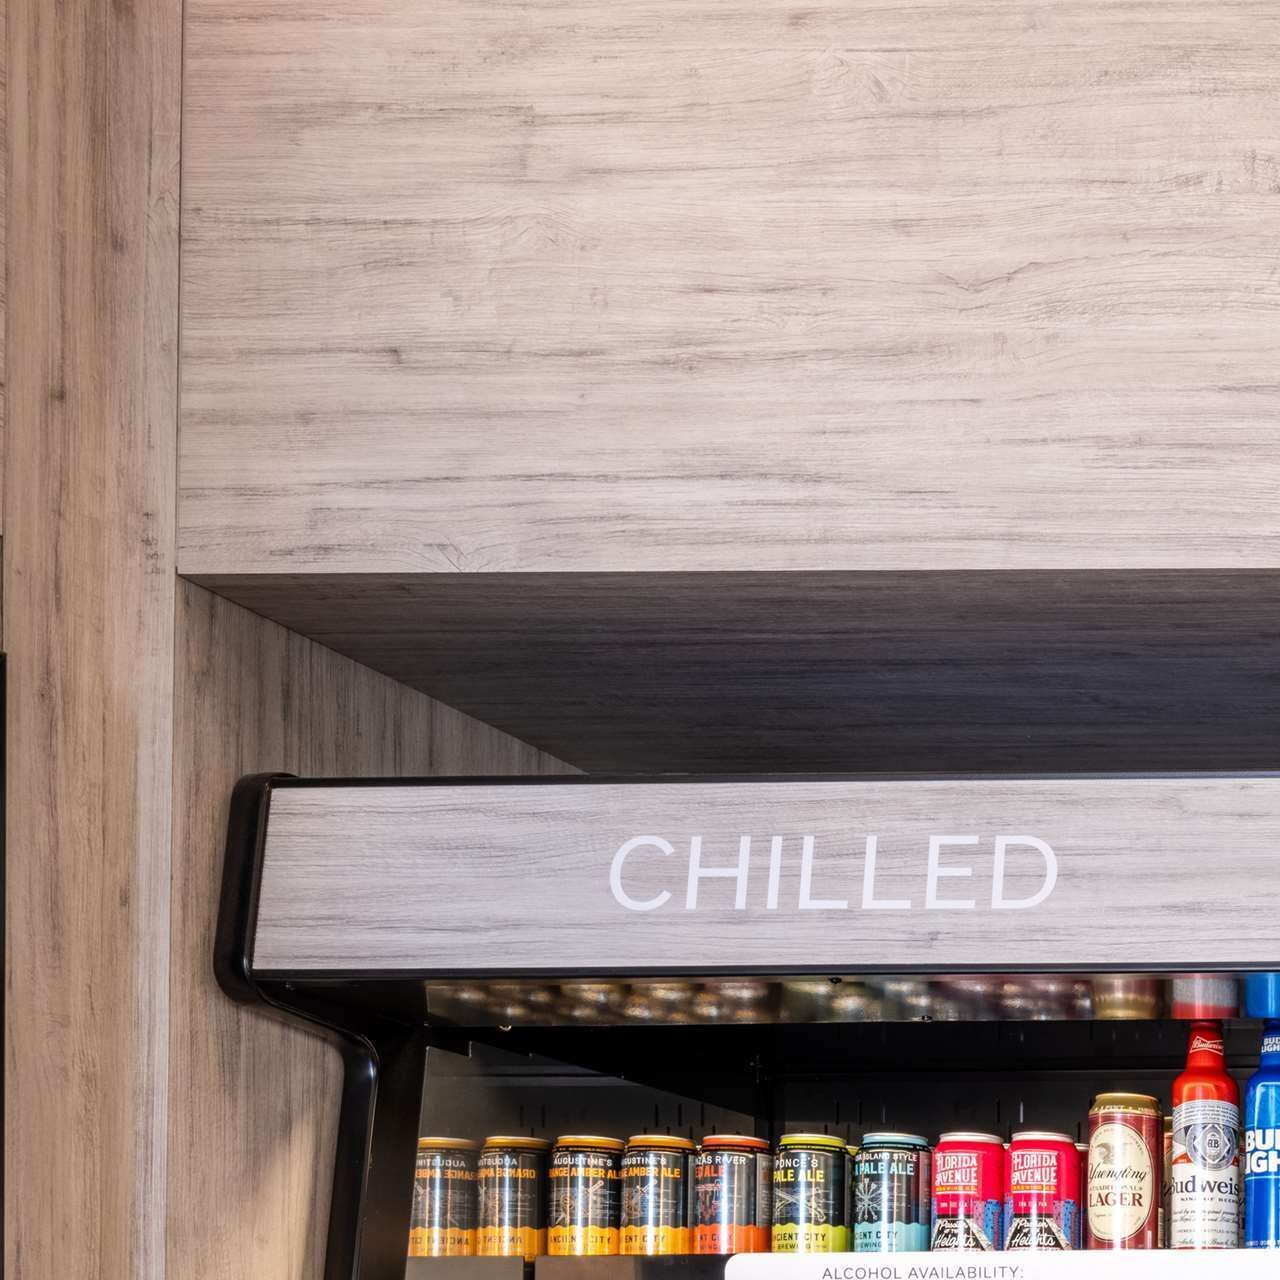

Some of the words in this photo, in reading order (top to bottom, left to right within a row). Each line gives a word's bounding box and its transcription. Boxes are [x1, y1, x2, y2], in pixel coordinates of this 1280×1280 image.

[609, 835, 1058, 911] CHILLED
[716, 1156, 746, 1166] RIVER
[775, 1156, 818, 1168] PONCE'S
[893, 1152, 918, 1162] STYLE
[935, 1153, 978, 1170] FLORIDA
[1011, 1153, 1057, 1170] FLORIDA
[571, 1167, 605, 1178] AMBER
[631, 1167, 659, 1178] AMBER
[661, 1167, 681, 1178] ALE
[704, 1165, 725, 1177] ALE
[860, 1162, 886, 1176] PALE
[890, 1163, 915, 1176] ALE
[935, 1167, 978, 1185] AVENUE
[1011, 1167, 1057, 1185] AVENUE
[1089, 1162, 1151, 1183] Yuengling
[773, 1170, 796, 1182] PALE
[798, 1170, 825, 1183] ALE
[1089, 1192, 1144, 1208] LAGER
[804, 1234, 826, 1242] CITY
[822, 1267, 902, 1280] ALCOHOL
[908, 1266, 1024, 1280] AVAILABILITY:
